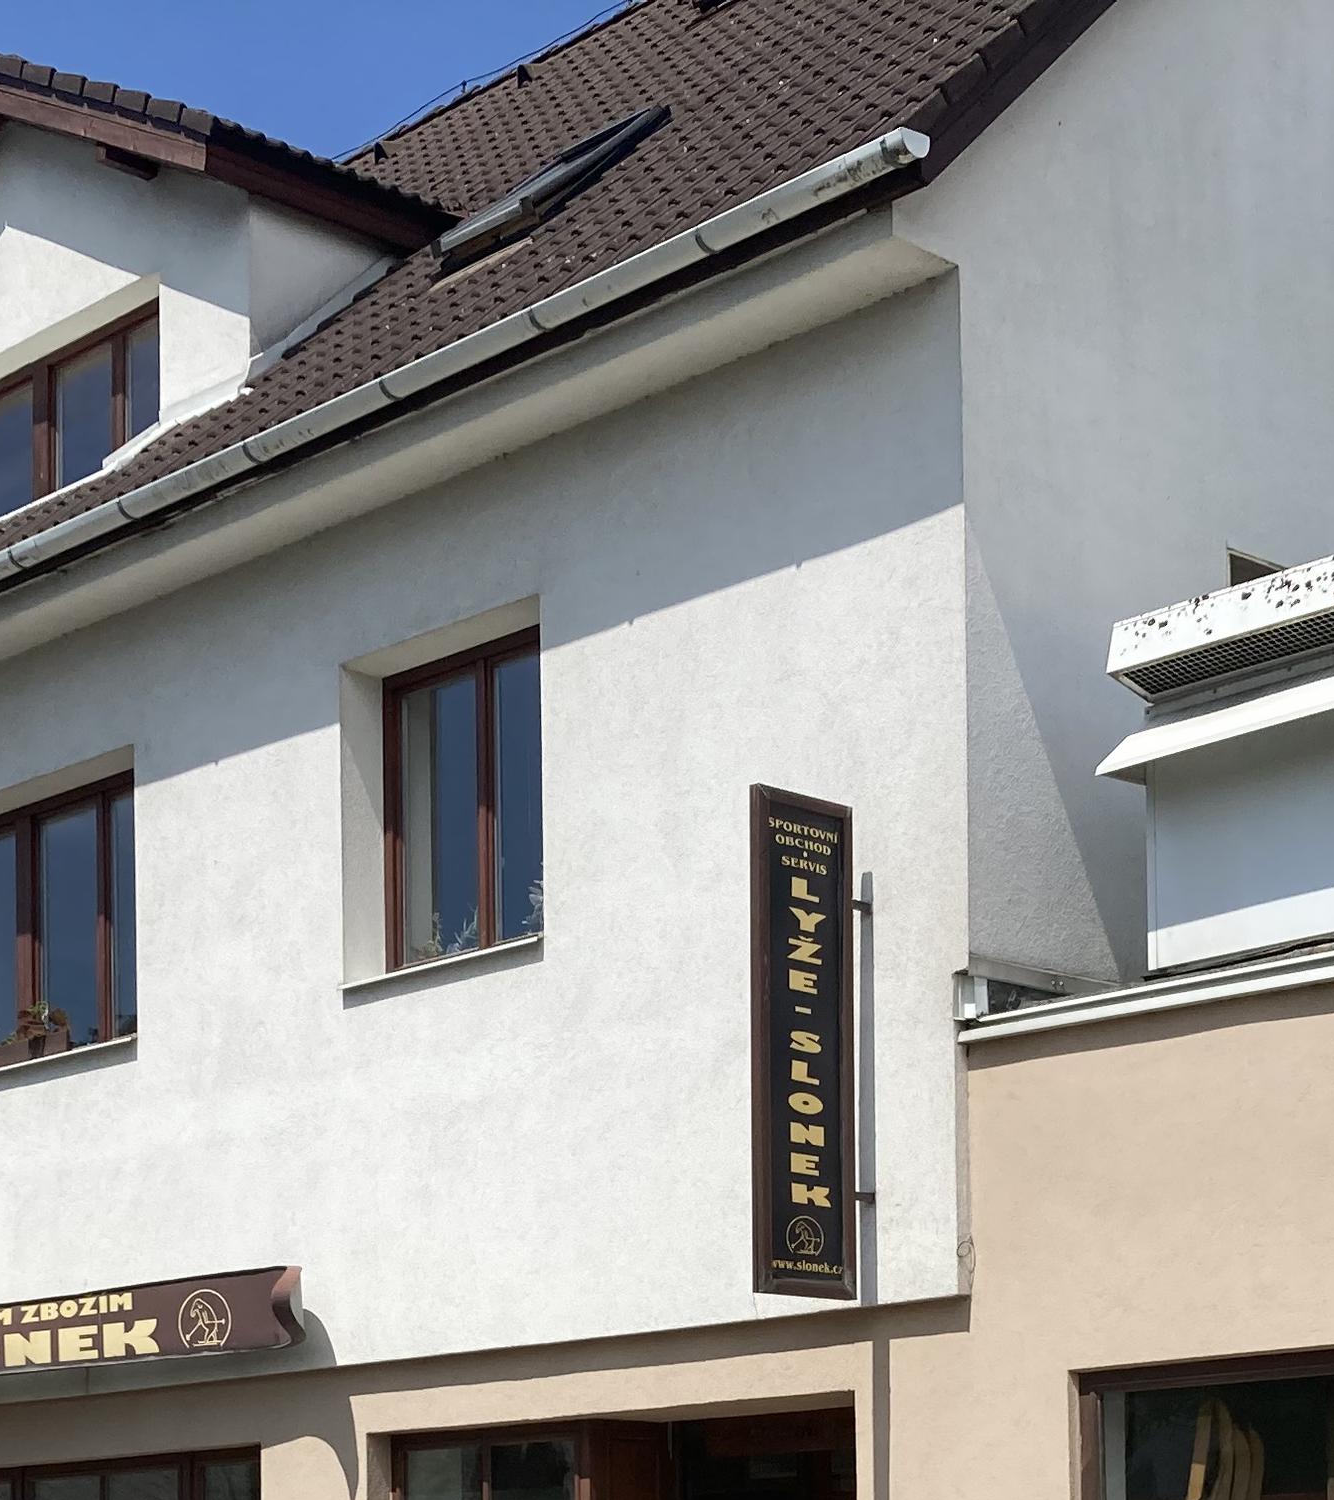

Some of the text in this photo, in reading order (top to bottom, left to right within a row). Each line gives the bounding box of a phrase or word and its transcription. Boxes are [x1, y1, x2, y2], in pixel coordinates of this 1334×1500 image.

[768, 816, 838, 844] SPORTOVNÍ
[775, 834, 831, 856] OBCHOD
[781, 855, 827, 875] SERVIS
[771, 1259, 843, 1275] www.slonek.cz
